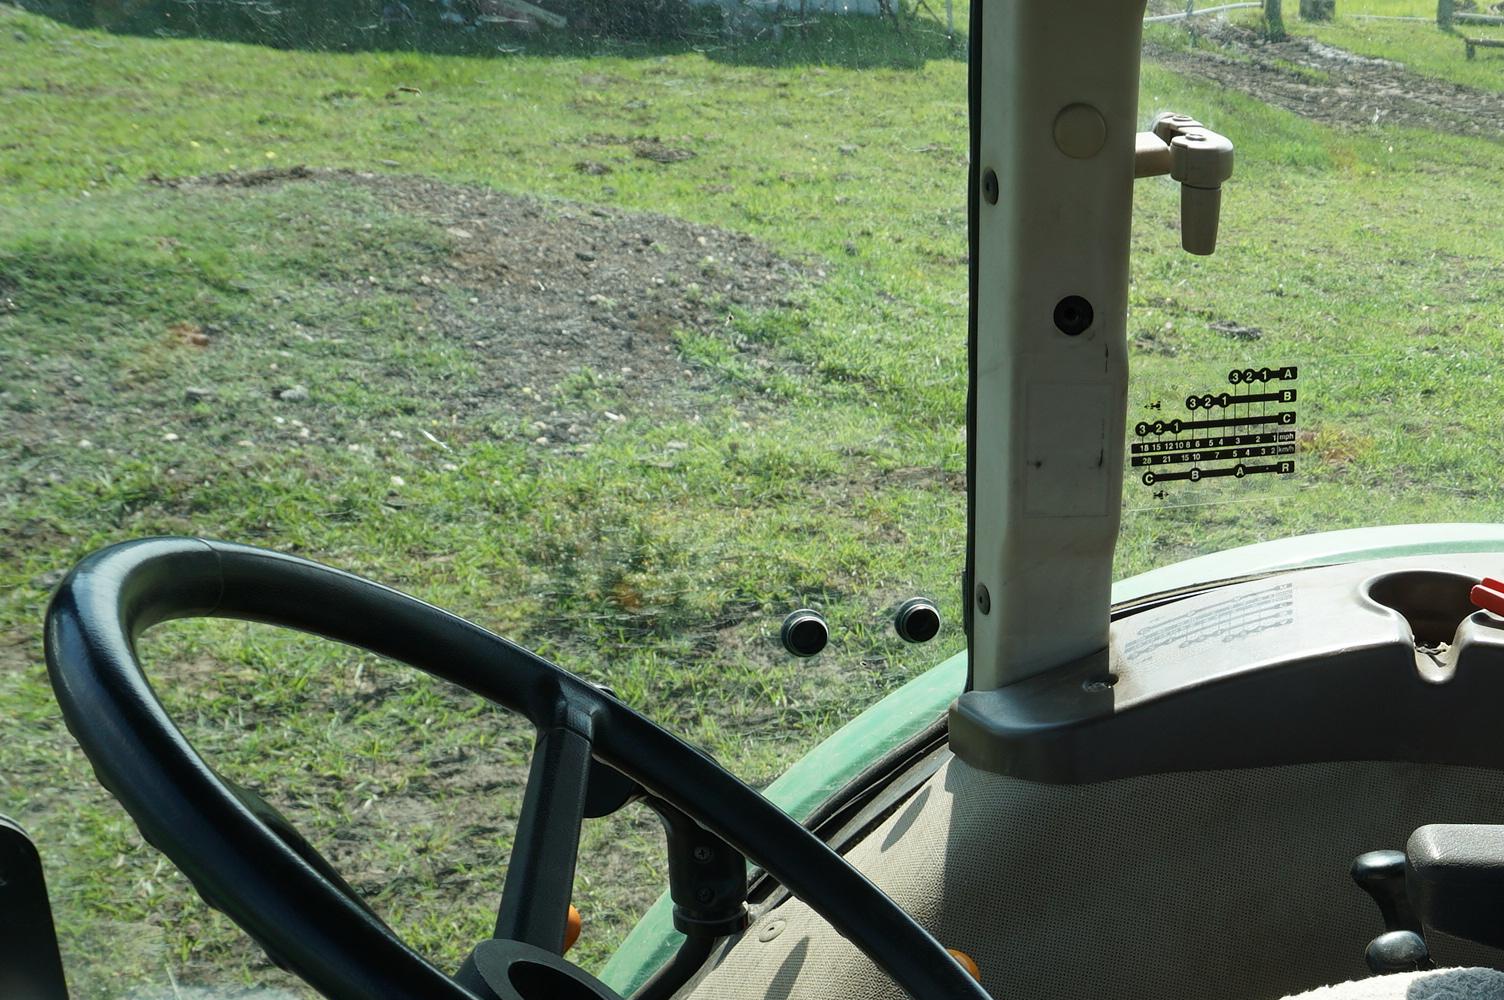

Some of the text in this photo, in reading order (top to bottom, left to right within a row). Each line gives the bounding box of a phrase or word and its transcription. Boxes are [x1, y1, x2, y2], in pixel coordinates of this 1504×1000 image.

[1140, 444, 1149, 452] 18
[1152, 443, 1161, 451] 15
[1164, 442, 1174, 450] 12
